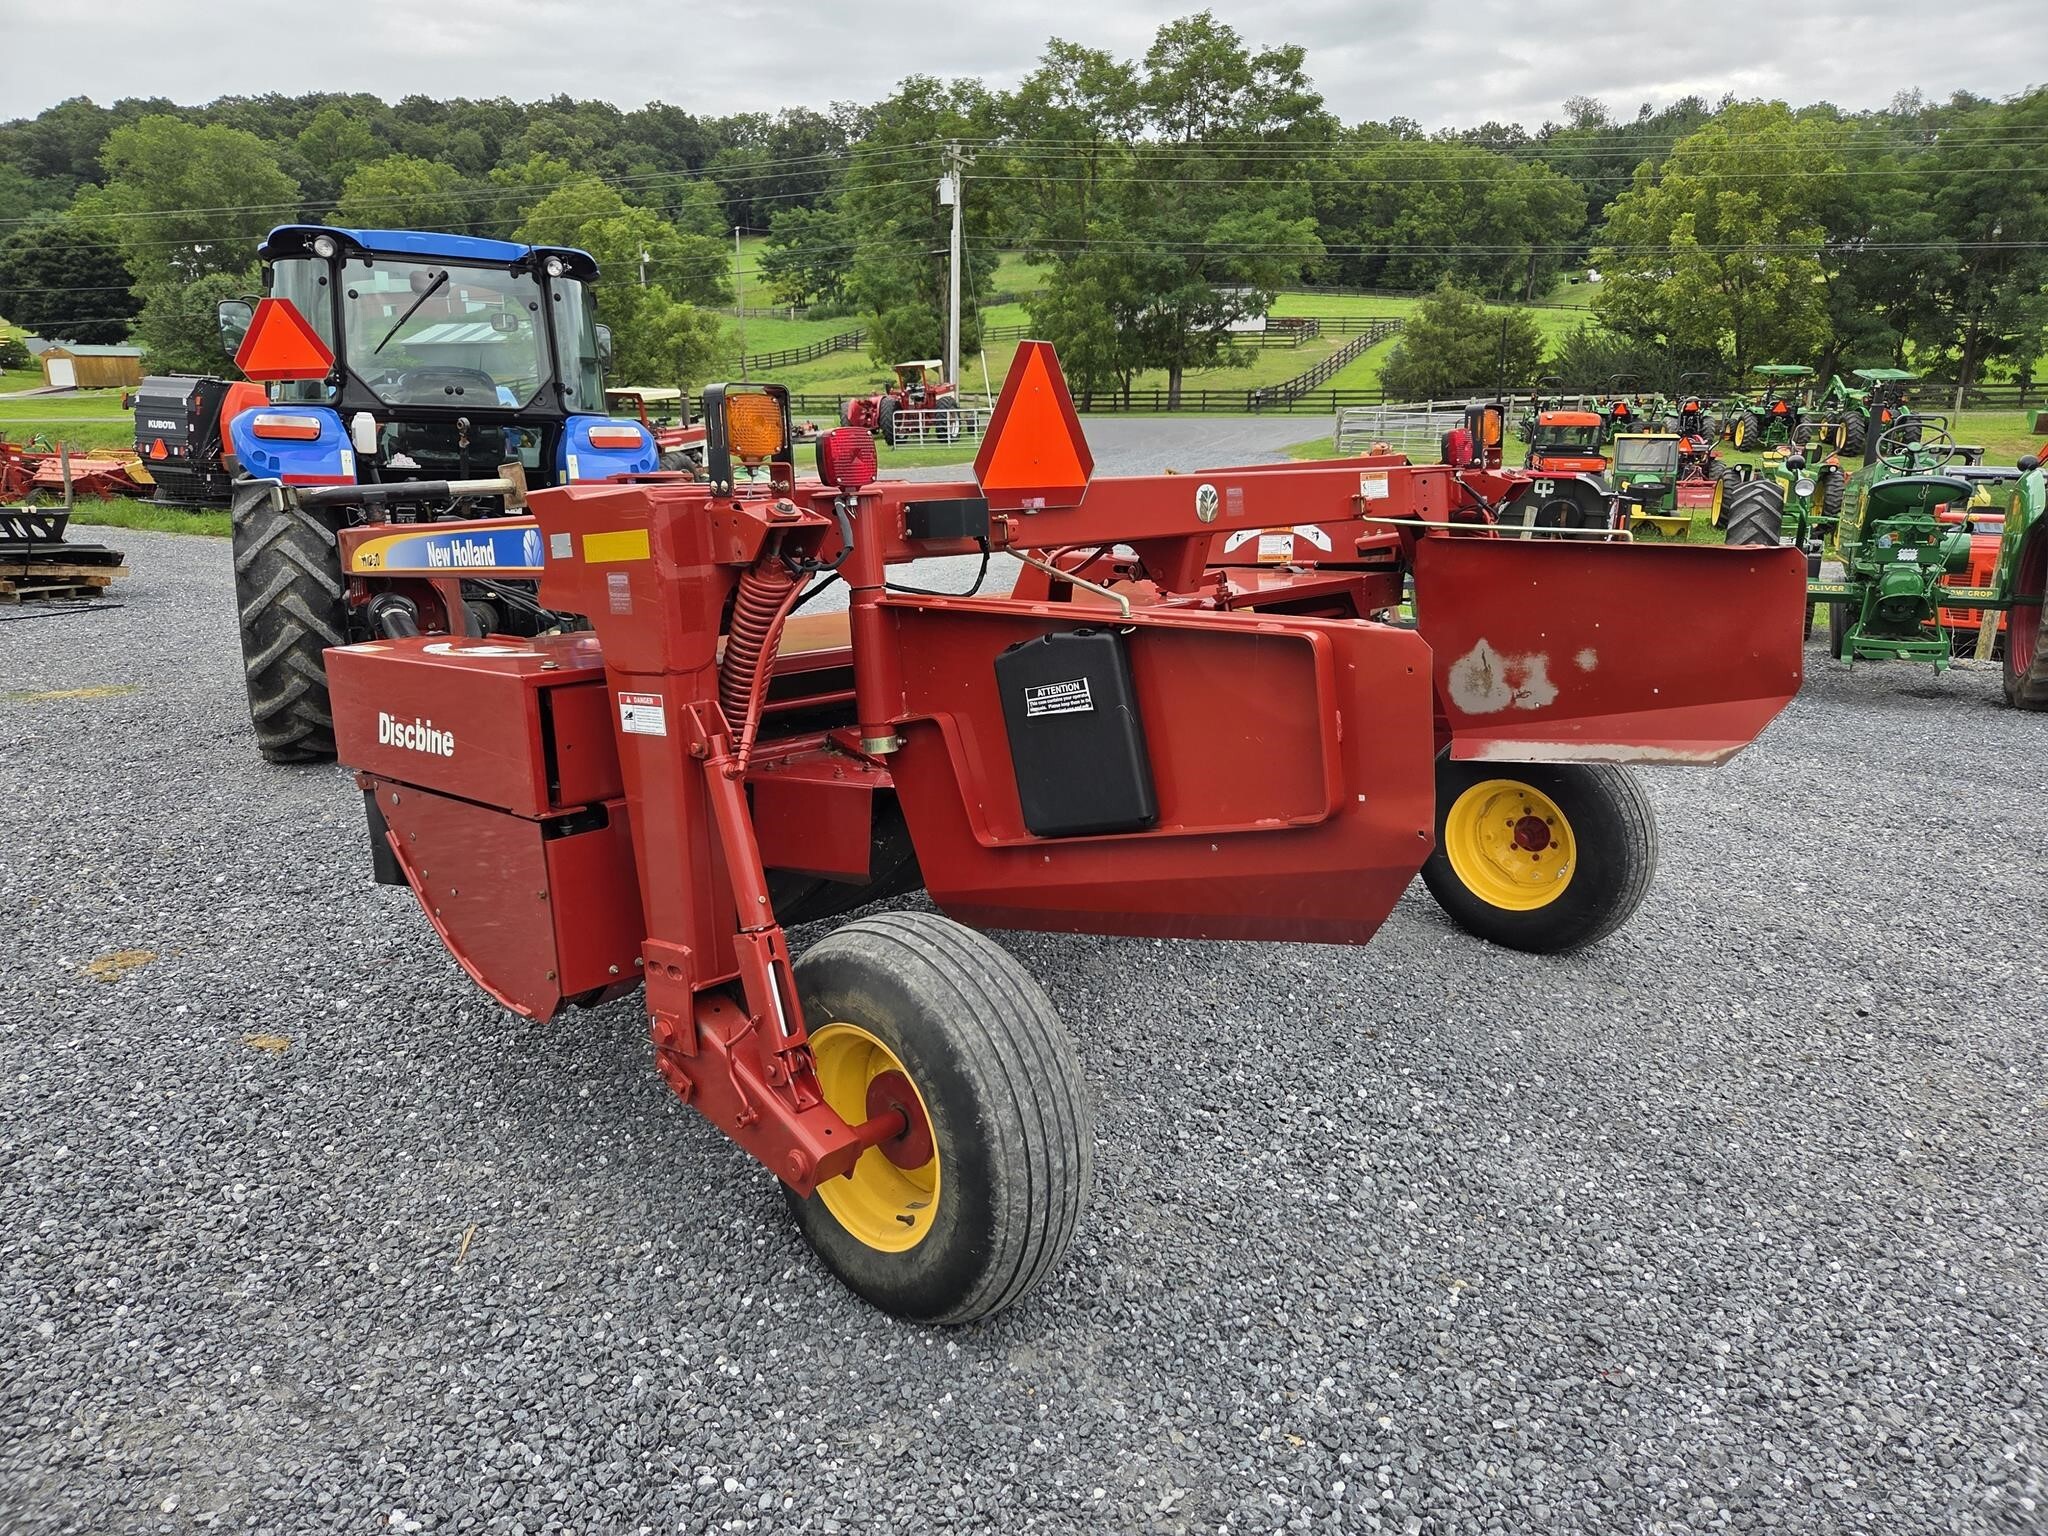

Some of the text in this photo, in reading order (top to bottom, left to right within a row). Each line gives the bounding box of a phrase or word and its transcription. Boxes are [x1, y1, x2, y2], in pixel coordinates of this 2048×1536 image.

[147, 420, 176, 430] KUBOTA
[427, 537, 496, 567] New Holland
[1807, 584, 1845, 592] OLIVER
[1967, 590, 1993, 598] CROP
[1037, 682, 1080, 697] ATTENTION
[379, 711, 454, 757] Discbine
